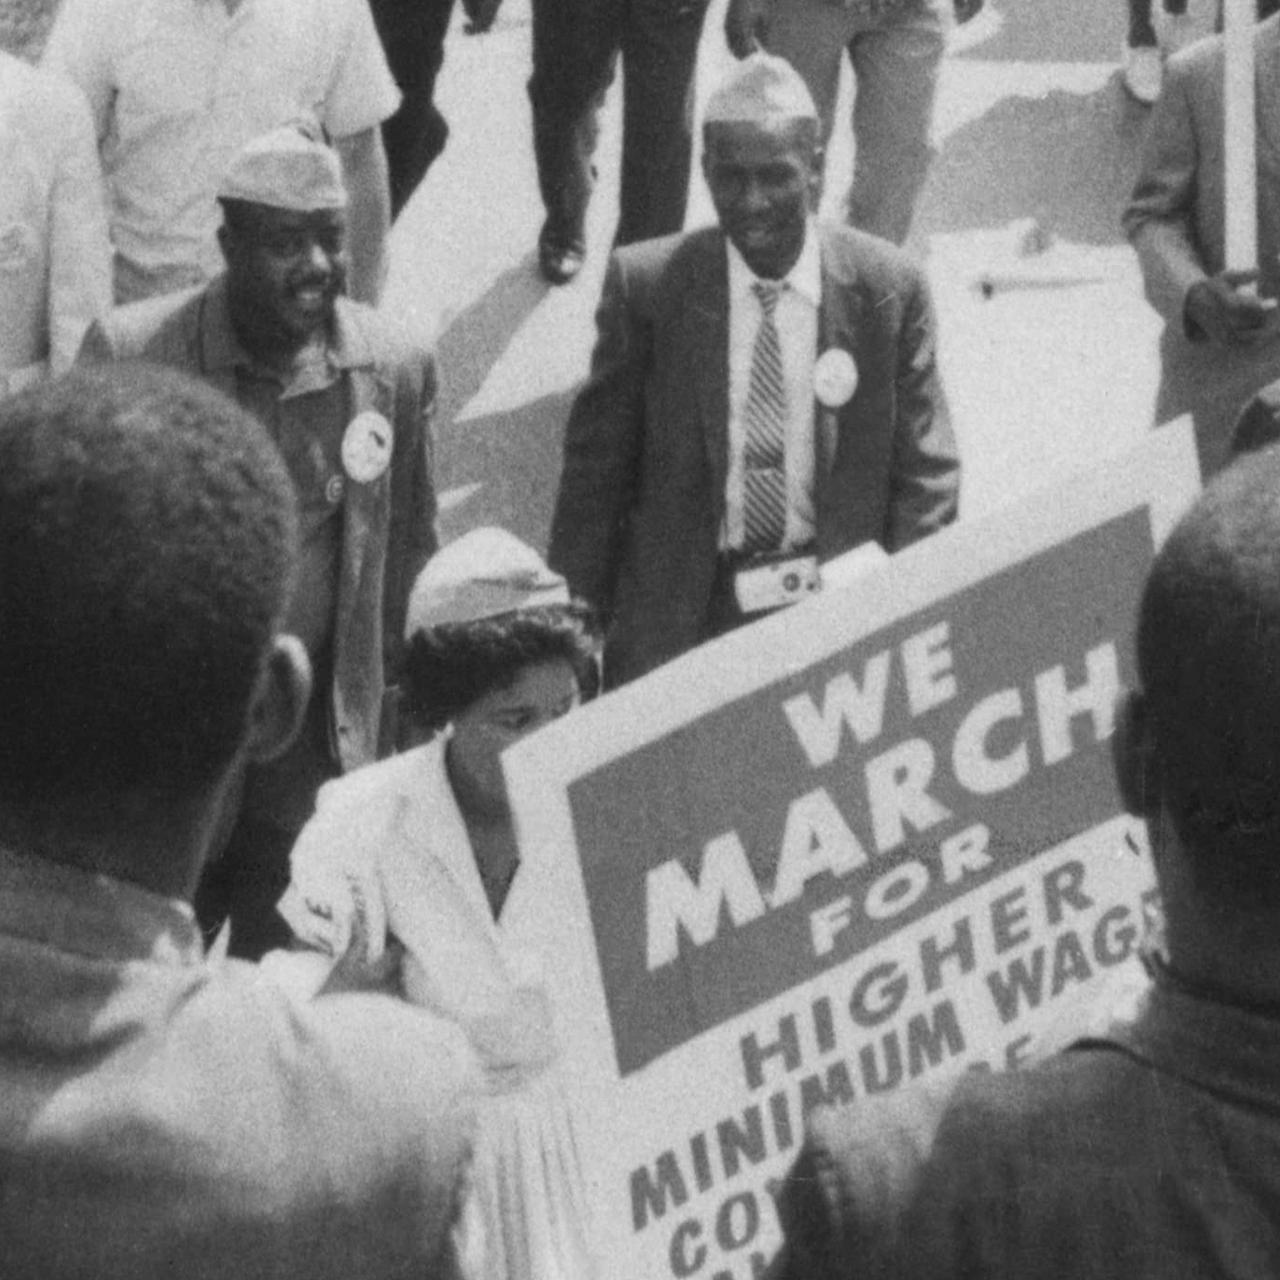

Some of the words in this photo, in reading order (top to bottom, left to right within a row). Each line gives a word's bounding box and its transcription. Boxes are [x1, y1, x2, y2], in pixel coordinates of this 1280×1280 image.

[644, 640, 1124, 974] MARCH
[782, 620, 958, 768] WE
[739, 859, 1096, 1092] HIGHER
[808, 822, 994, 957] FOR
[628, 997, 968, 1235] MINIMUM
[985, 888, 1162, 1025] WAG
